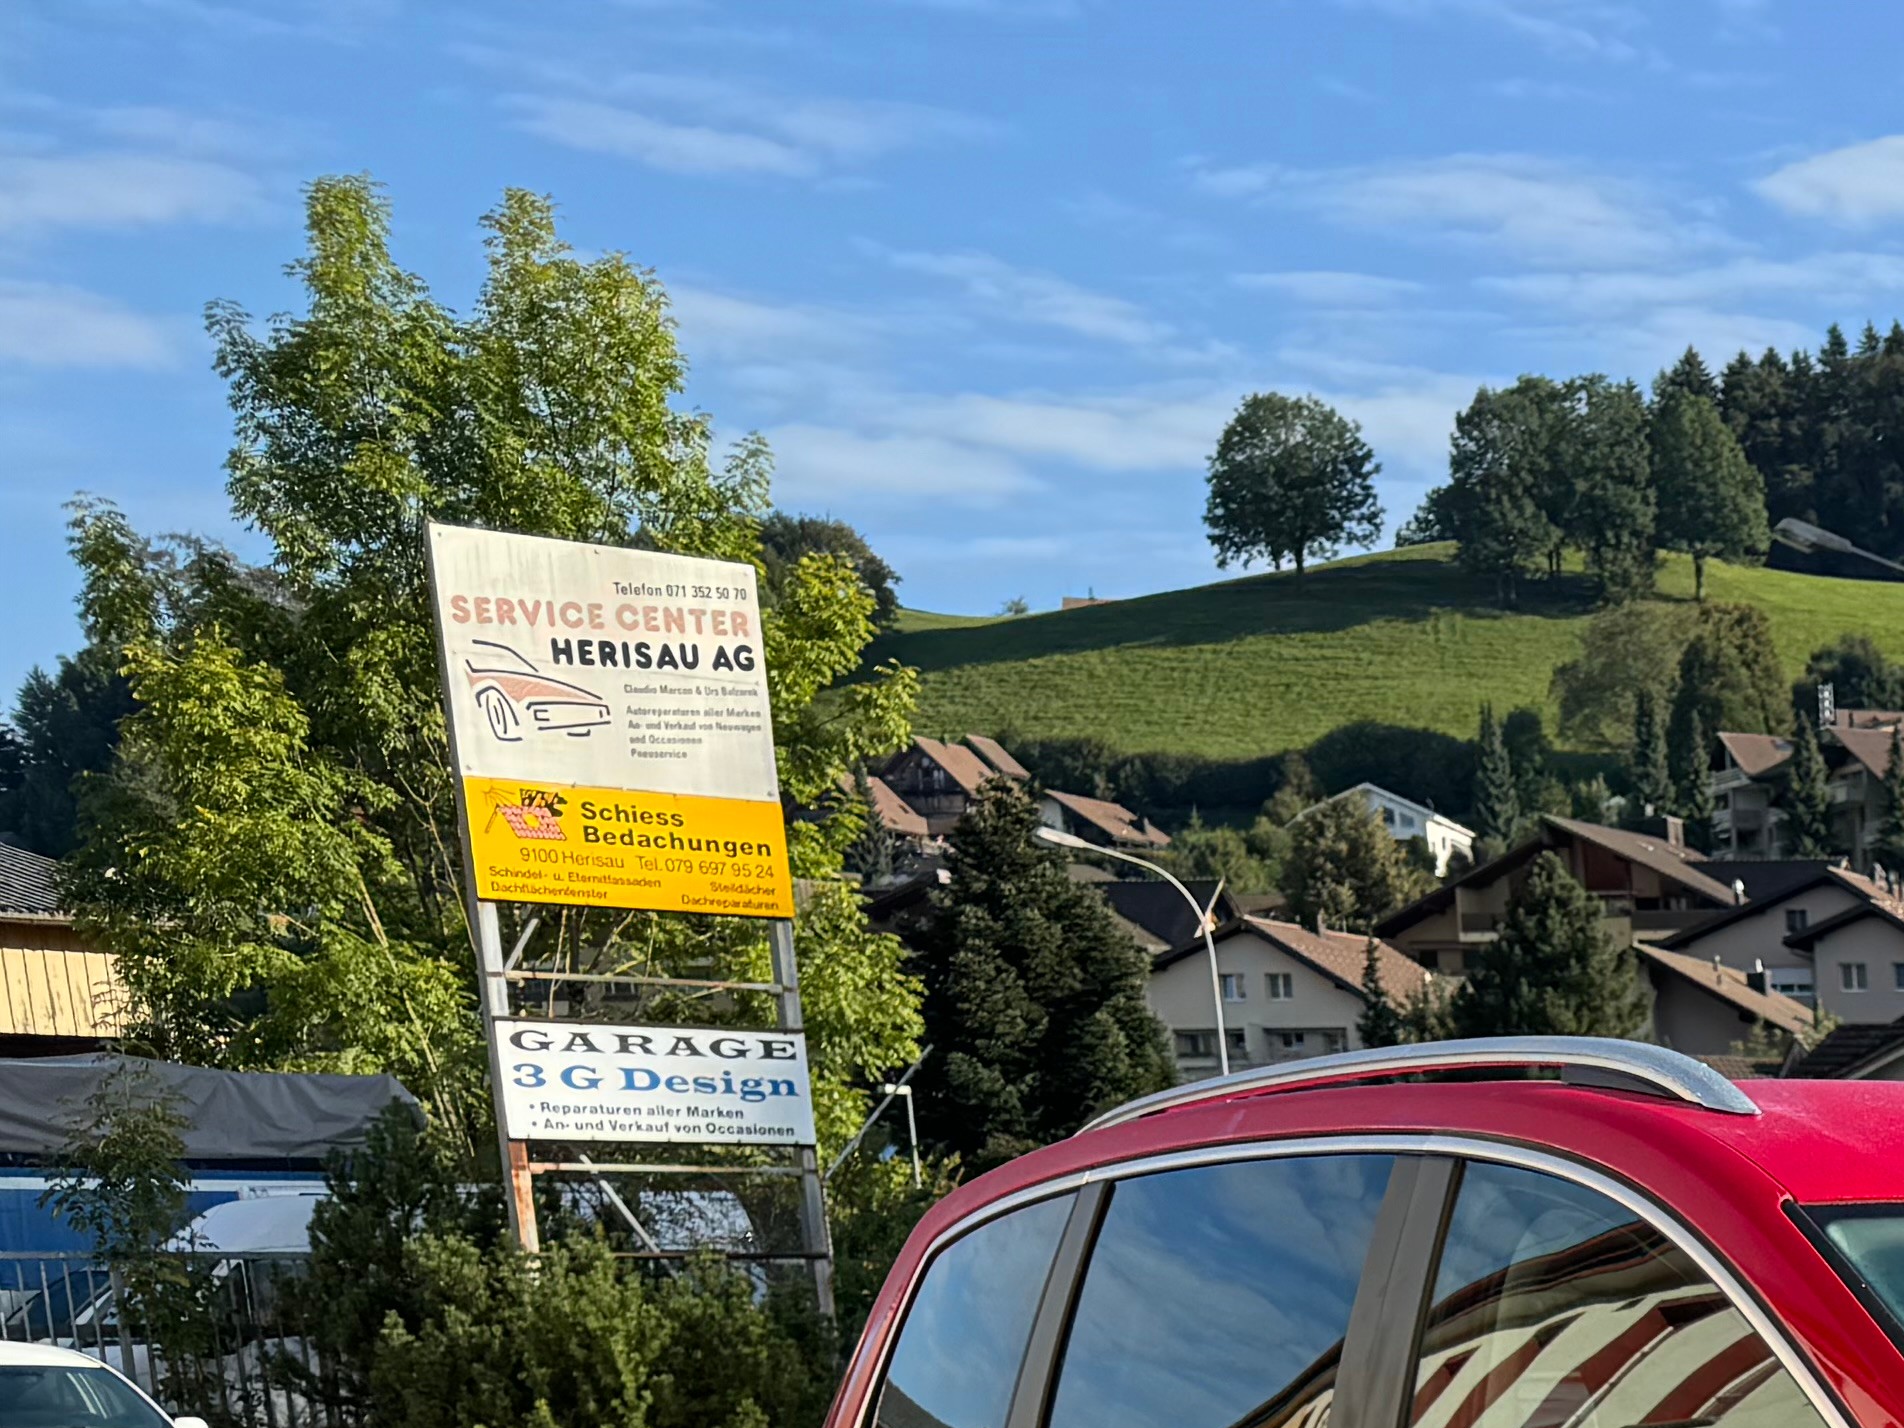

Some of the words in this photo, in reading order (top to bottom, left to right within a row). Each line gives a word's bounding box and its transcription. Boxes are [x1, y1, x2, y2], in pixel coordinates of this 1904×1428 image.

[612, 582, 663, 597] Telefon
[665, 585, 687, 598] 071
[691, 586, 712, 599] 352
[715, 587, 730, 600] 50
[732, 587, 748, 600] 70
[450, 594, 606, 630] SERVICE
[614, 602, 750, 638] CENTER
[550, 637, 700, 670] HERISAU
[712, 644, 755, 672] AG
[695, 685, 703, 696] &
[626, 705, 701, 718] Autoreparaturen
[703, 706, 724, 718] aller
[725, 707, 762, 719] Marken
[645, 720, 661, 730] und
[663, 721, 697, 731] Verkauf
[699, 723, 713, 731] von
[629, 735, 646, 745] und
[648, 735, 703, 745] Occasionen
[630, 747, 688, 759] Pneuservice
[580, 801, 685, 828] Schiess
[583, 826, 773, 858] Bedachungen
[519, 847, 559, 864] 9100
[561, 850, 625, 869] Herisau
[635, 856, 663, 872] Tel.
[664, 858, 693, 874] 079
[698, 860, 727, 876] 697
[731, 862, 752, 878] 95
[755, 864, 775, 879] 24
[681, 893, 780, 911] Dachreparaturen
[509, 1030, 798, 1060] GARAGE
[617, 1067, 800, 1103] Design
[540, 1101, 642, 1117] Reparaturen
[646, 1105, 681, 1117] aller
[686, 1106, 745, 1120] Marken
[544, 1118, 570, 1130] An-
[575, 1119, 604, 1132] und
[609, 1120, 670, 1133] Verkauf
[674, 1124, 702, 1134] von
[705, 1122, 796, 1137] Occasionen
